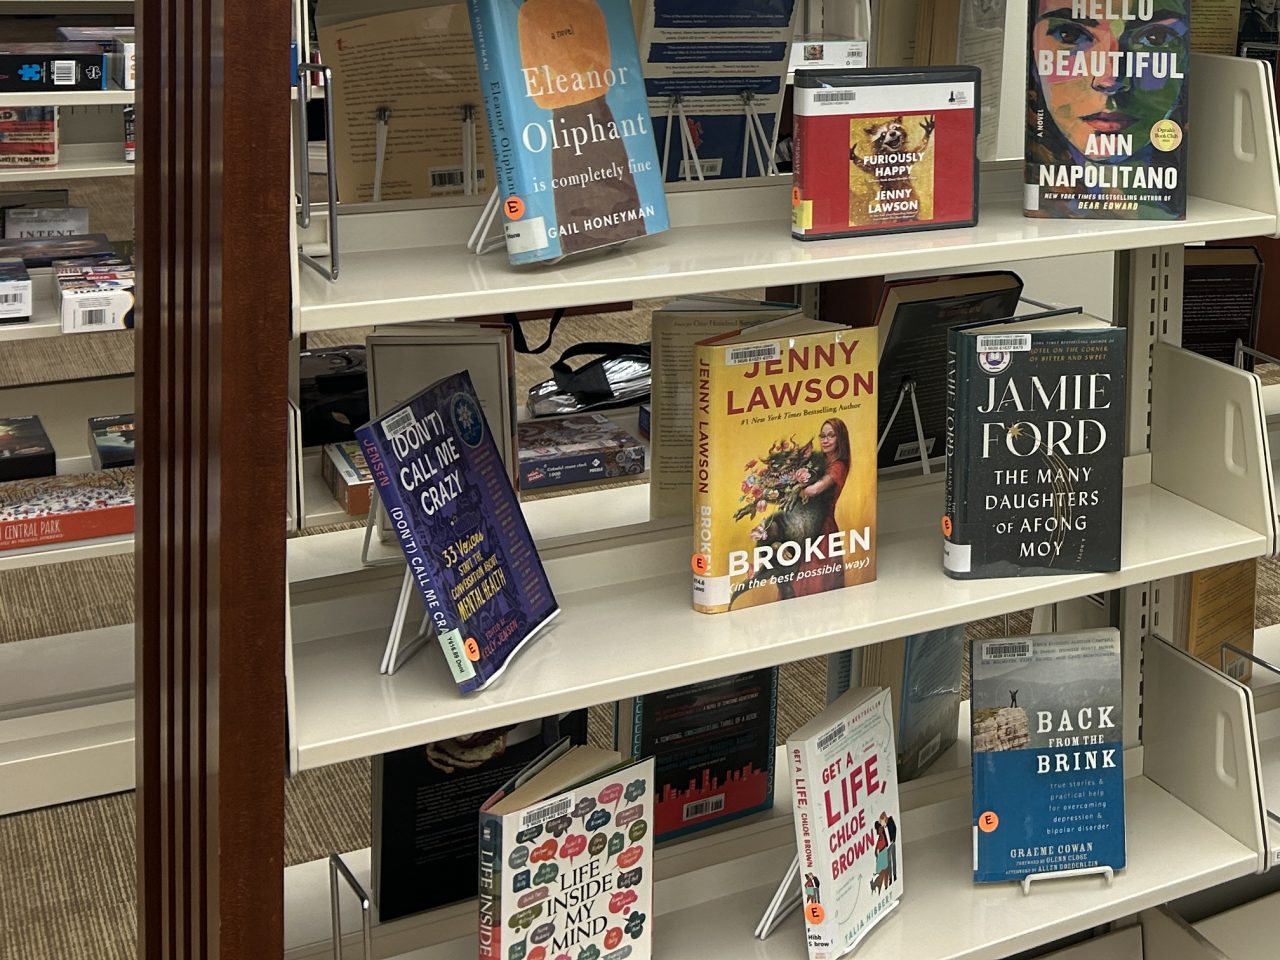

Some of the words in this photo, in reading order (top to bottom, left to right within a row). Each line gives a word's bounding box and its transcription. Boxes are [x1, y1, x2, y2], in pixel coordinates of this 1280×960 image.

[1038, 49, 1184, 80] BEAUTIFUL
[520, 64, 629, 98] Eleanor
[522, 110, 648, 156] Oliphant
[1084, 133, 1132, 156] ANN
[863, 151, 925, 166] FURIOUSLY
[875, 164, 913, 177] HAPPY
[1039, 164, 1178, 190] NAPOLITANO
[868, 199, 918, 213] LAWSON
[874, 188, 912, 201] JENNY
[1078, 202, 1099, 210] DEAR
[1103, 202, 1138, 210] EDWARD
[548, 218, 579, 239] GAIL
[583, 205, 655, 231] HONEYMAN
[744, 340, 860, 379] JENNY
[726, 371, 874, 415] LAWSON
[977, 373, 1112, 413] JAMIE
[981, 419, 1107, 459] FORD
[399, 454, 438, 491] CALL
[439, 436, 460, 470] ME
[994, 469, 1028, 485] THE
[1036, 466, 1092, 484] MANY
[420, 470, 464, 516] CRAZY
[985, 490, 1099, 510] DAUGHTERS
[996, 522, 1014, 534] OF
[1020, 515, 1087, 533] AFONG
[728, 526, 871, 576] BROKEN
[1019, 541, 1063, 557] MOY
[1037, 706, 1116, 734] BACK
[1048, 737, 1079, 749] FROM
[1082, 734, 1104, 747] THE
[822, 760, 842, 785] GET
[845, 752, 854, 768] A
[1037, 748, 1117, 774] BRINK
[829, 809, 866, 854] CHLOE
[1053, 814, 1094, 823] depression
[832, 835, 875, 881] BROWN
[1010, 845, 1054, 859] GRAEME
[1057, 842, 1093, 854] COWAN
[560, 859, 601, 892] LIFE
[547, 873, 613, 918] INSIDE
[565, 899, 595, 929] MY
[550, 915, 608, 955] MIND
